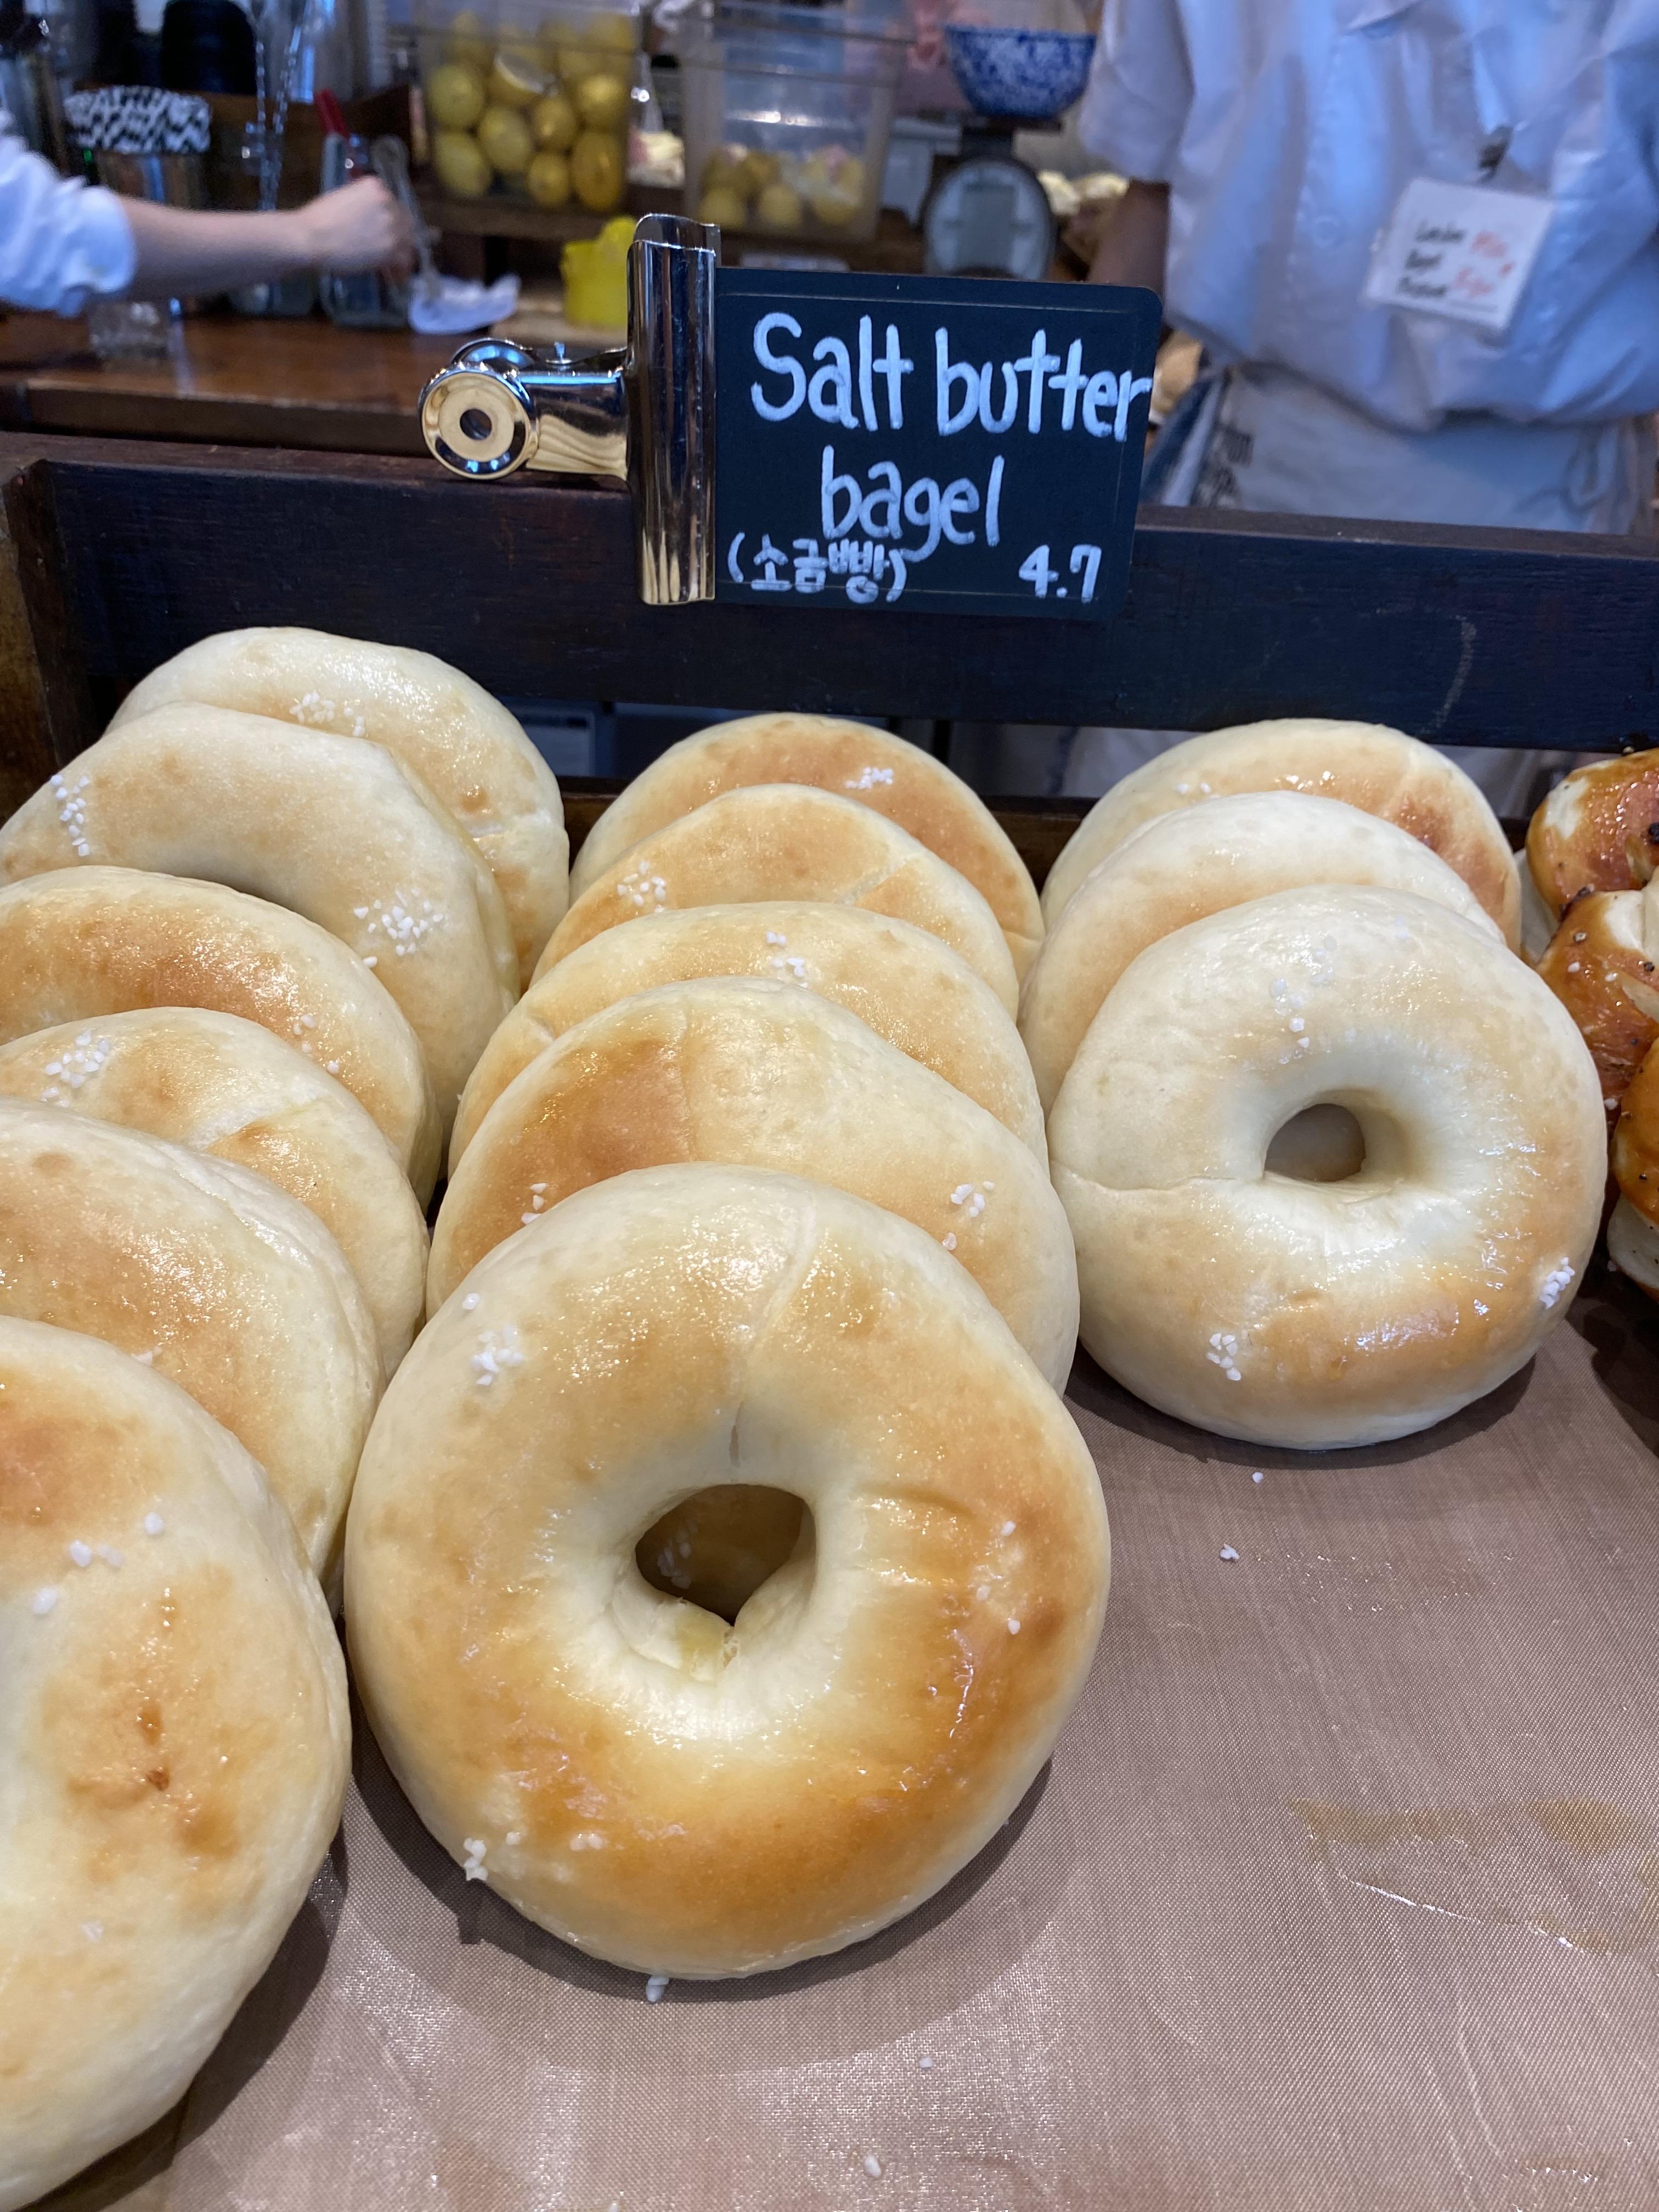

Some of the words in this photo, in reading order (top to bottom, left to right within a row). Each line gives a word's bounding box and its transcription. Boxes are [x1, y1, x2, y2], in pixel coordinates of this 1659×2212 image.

[751, 312, 914, 432] Salt
[935, 327, 1153, 441] butter
[821, 445, 1005, 562] bagel
[727, 532, 907, 604] (소금빵)
[1018, 545, 1102, 603] 4.7
